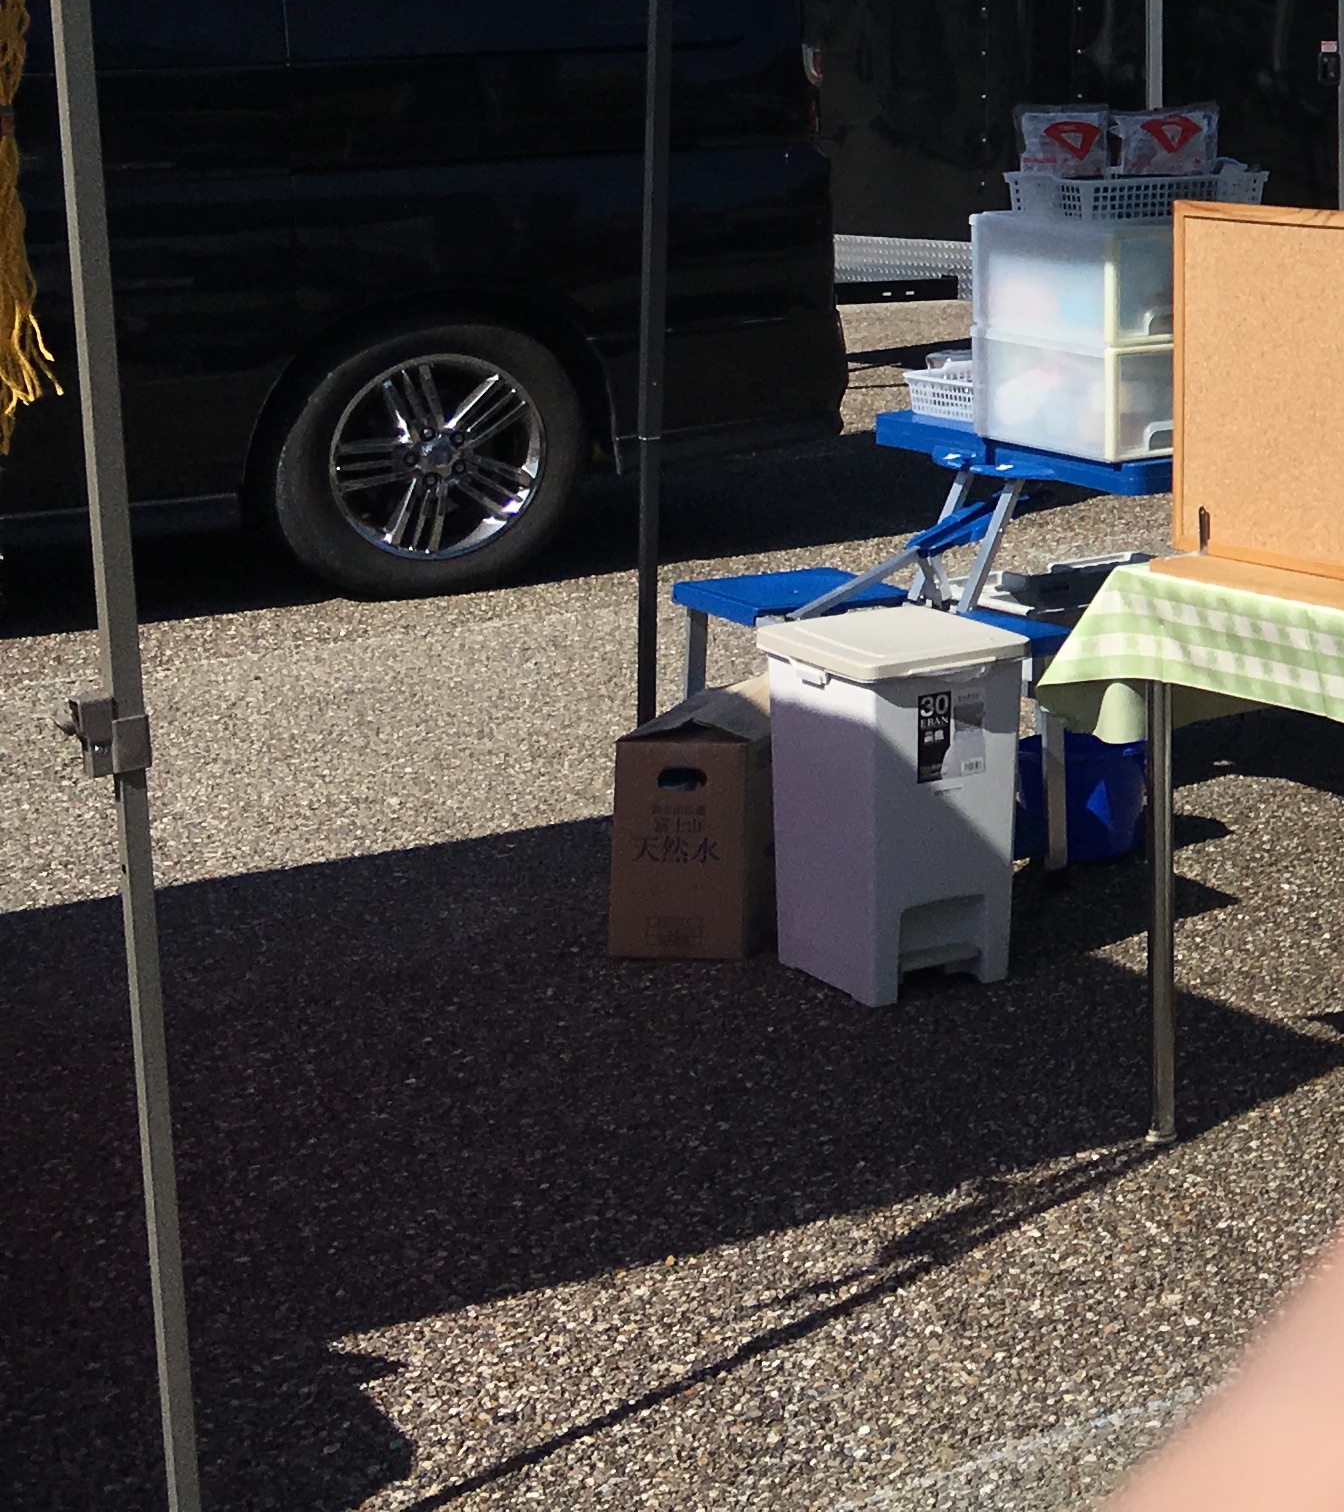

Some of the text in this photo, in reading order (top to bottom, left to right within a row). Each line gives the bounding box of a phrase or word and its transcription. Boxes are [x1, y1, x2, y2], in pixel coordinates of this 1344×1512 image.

[920, 694, 949, 717] 30
[632, 835, 721, 864] 天然水
